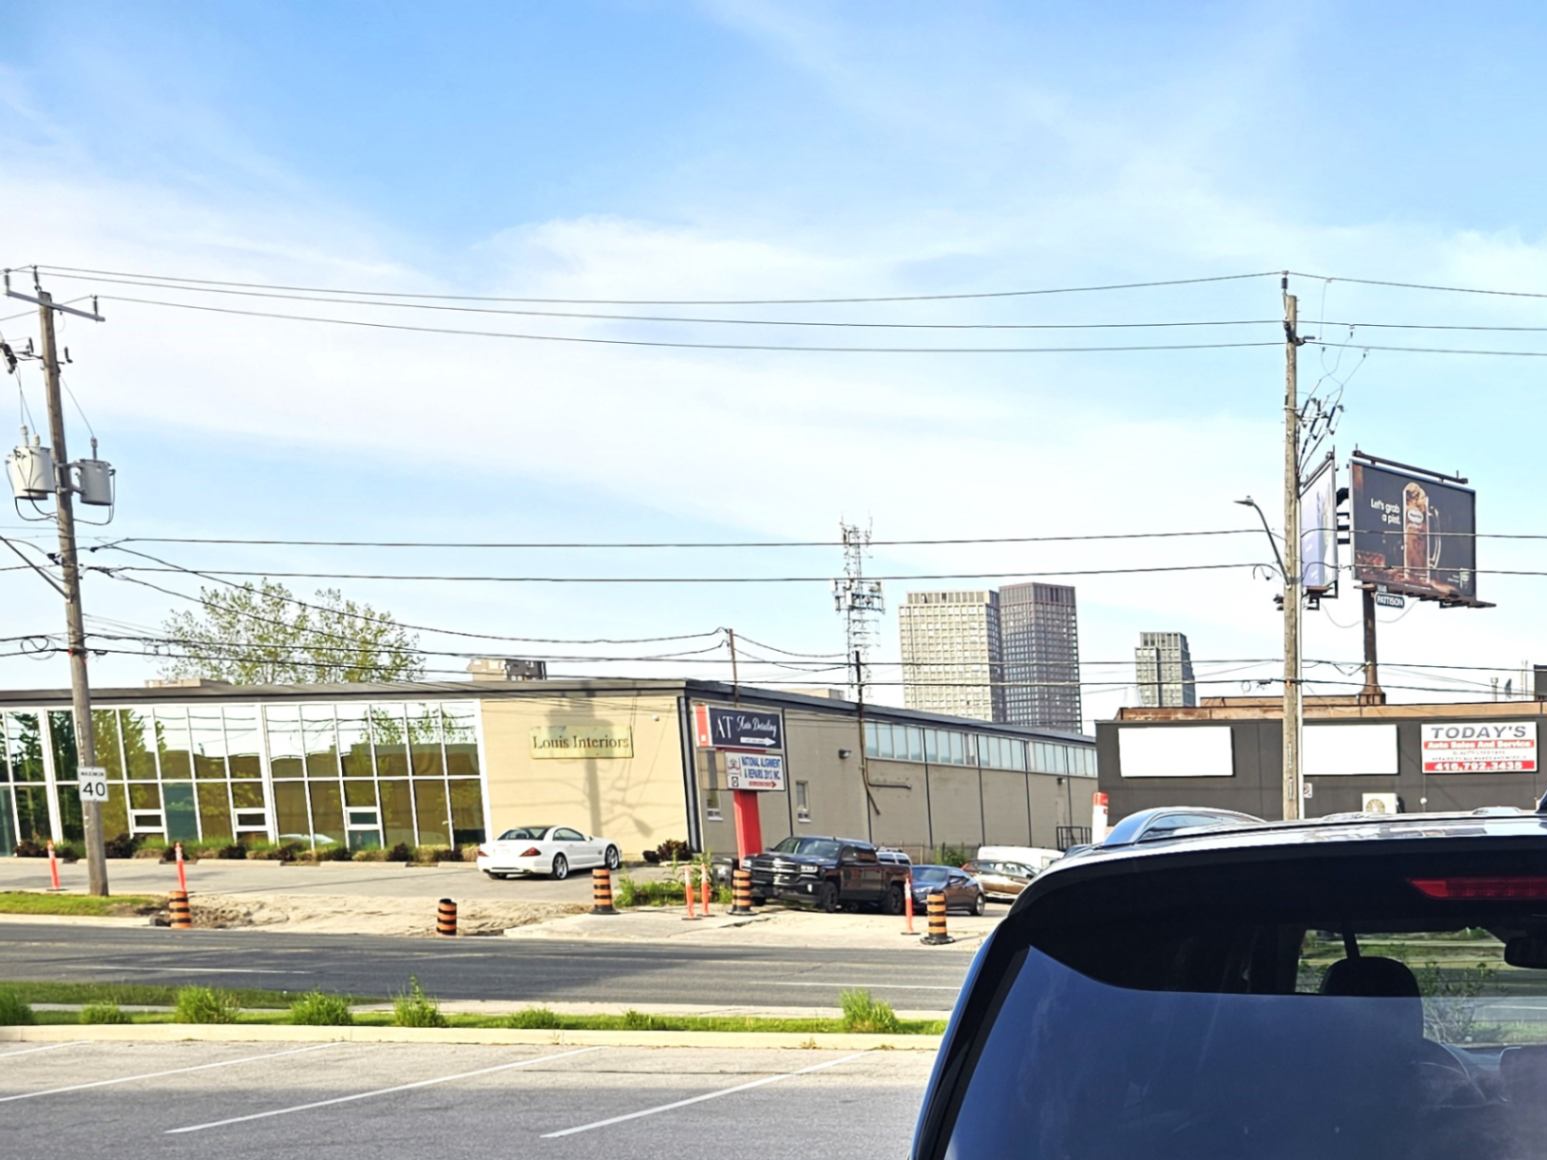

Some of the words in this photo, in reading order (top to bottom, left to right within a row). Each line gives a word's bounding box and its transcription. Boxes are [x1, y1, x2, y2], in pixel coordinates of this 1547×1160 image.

[1430, 725, 1527, 739] TODAY'S
[533, 735, 569, 749] Louis
[573, 734, 629, 749] Interiors
[82, 781, 106, 797] 40
